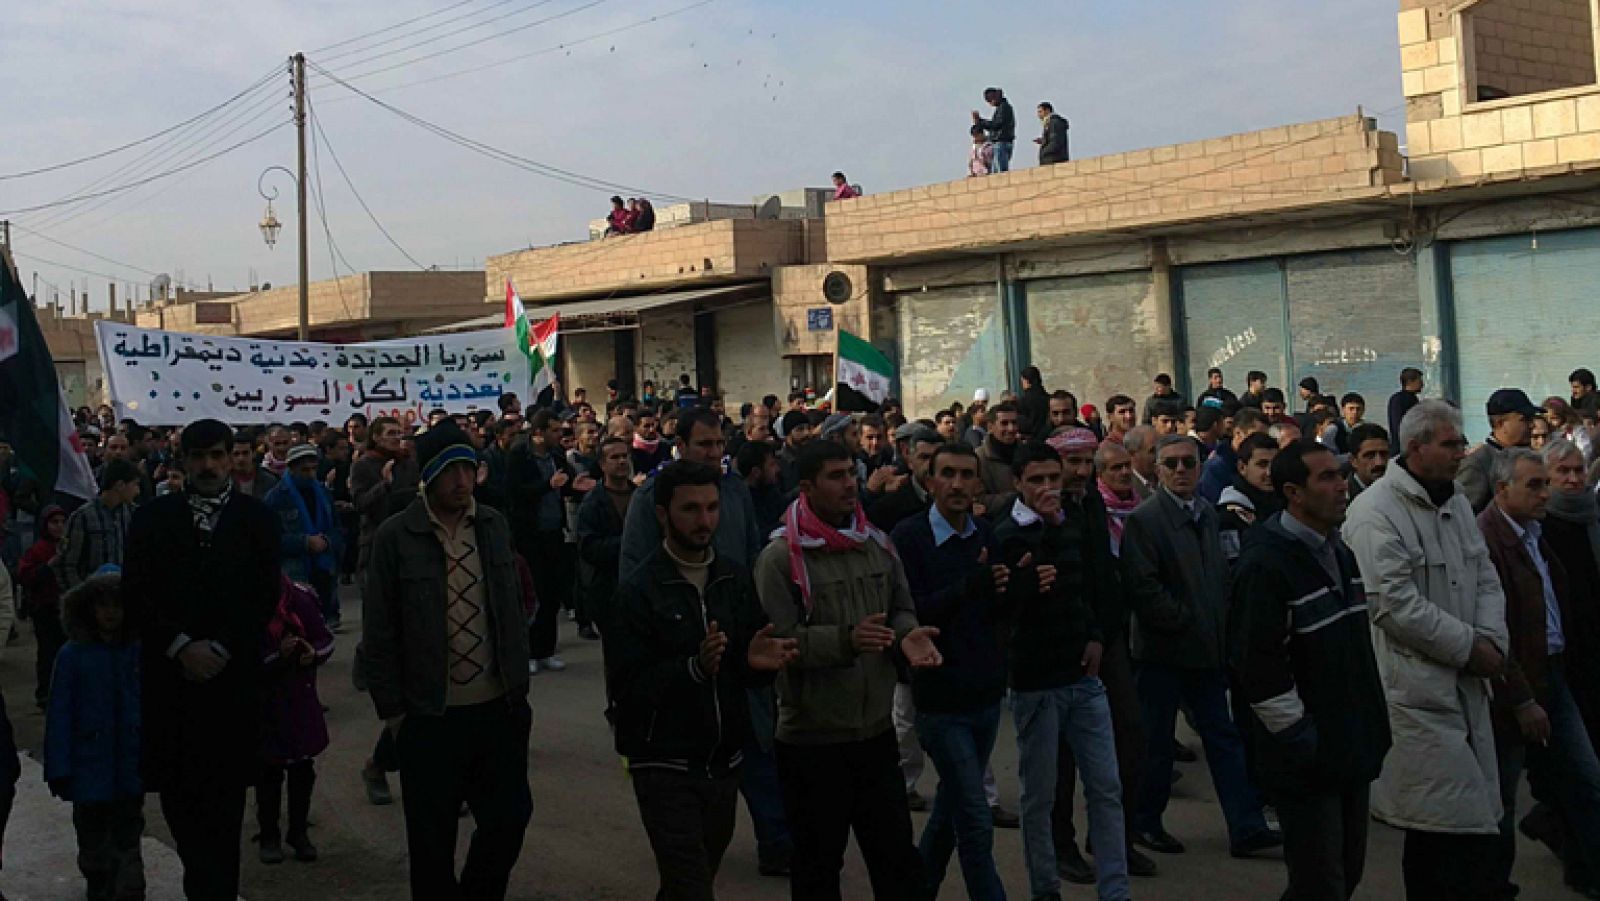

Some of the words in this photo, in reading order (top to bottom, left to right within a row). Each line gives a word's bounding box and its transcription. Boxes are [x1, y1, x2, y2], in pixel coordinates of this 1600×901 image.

[115, 332, 241, 370] ديمقراطية
[250, 343, 318, 373] مدنية
[440, 343, 505, 371] سوريا
[225, 378, 341, 412] السوريين
[350, 376, 407, 406] لكل
[417, 371, 503, 407] تعددية
